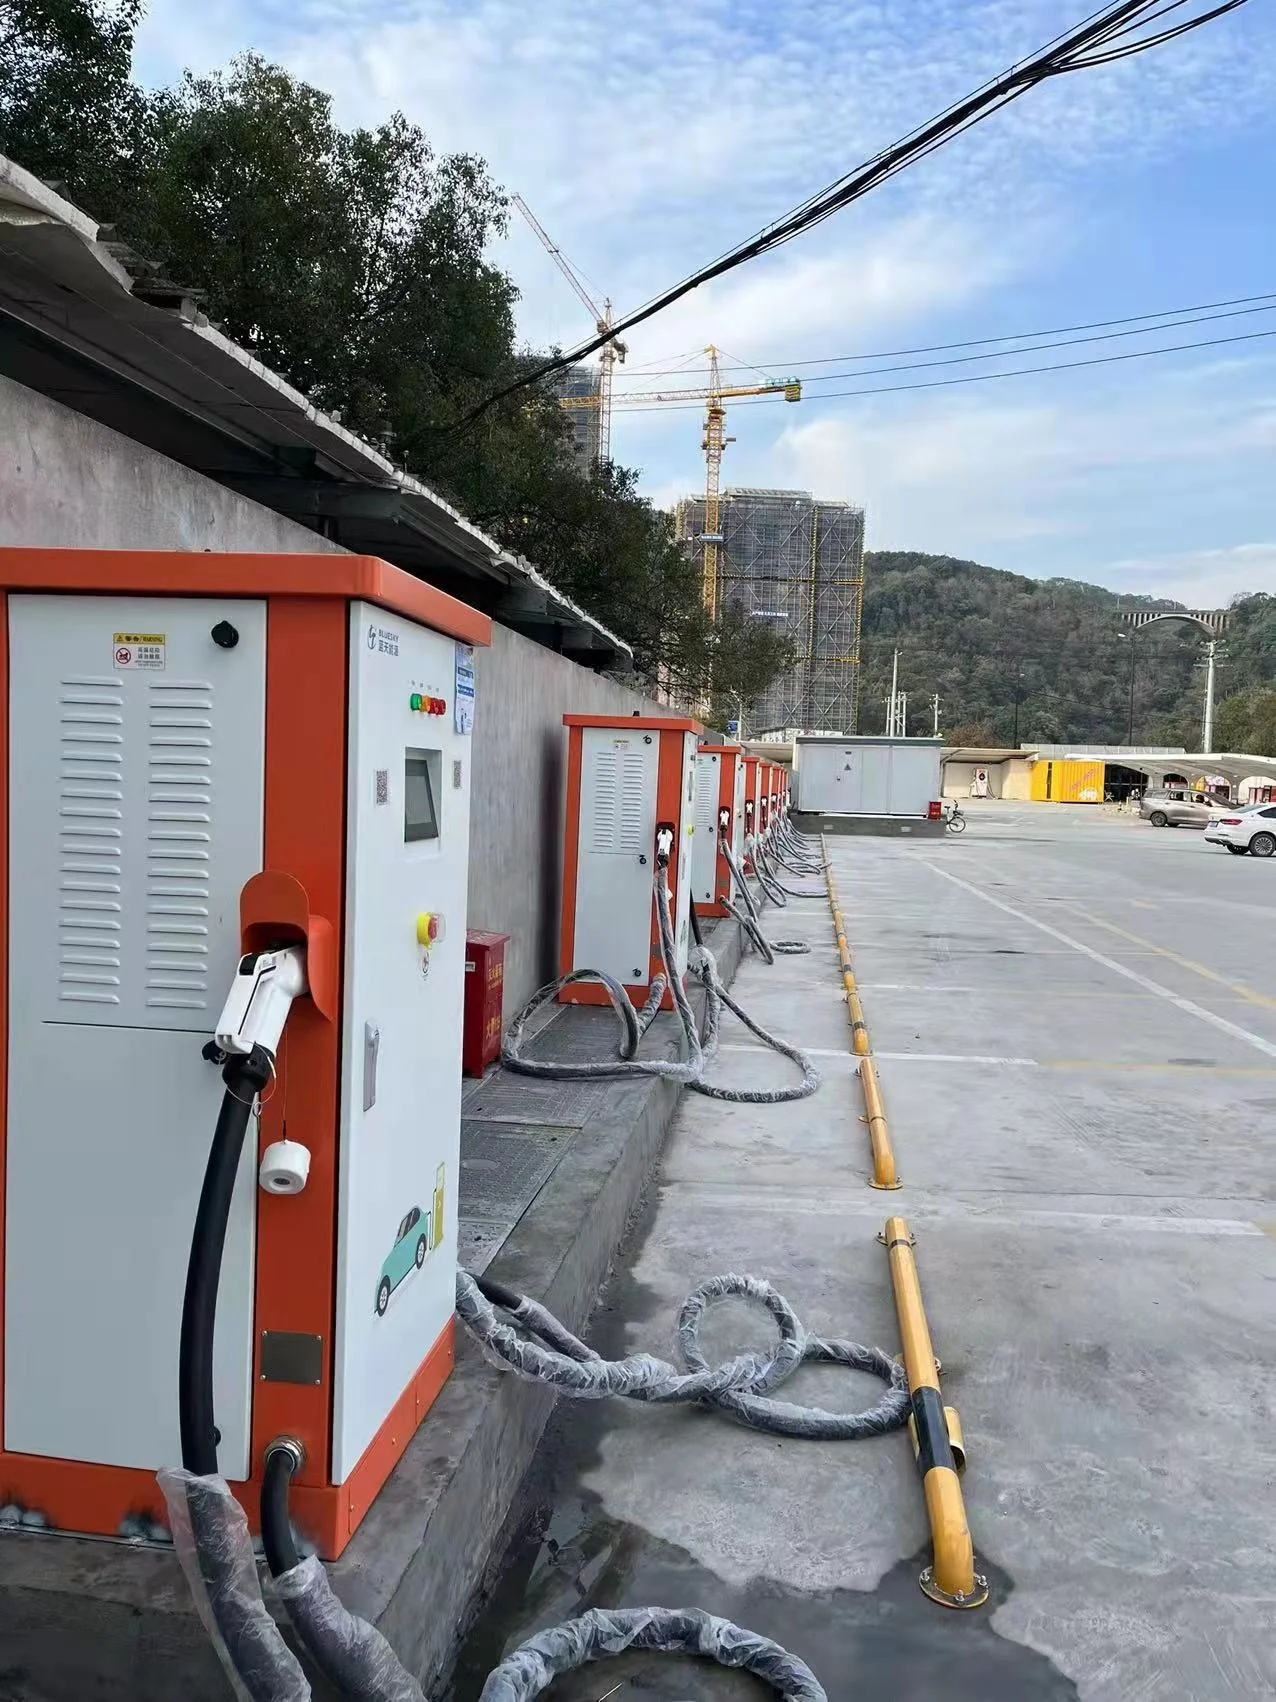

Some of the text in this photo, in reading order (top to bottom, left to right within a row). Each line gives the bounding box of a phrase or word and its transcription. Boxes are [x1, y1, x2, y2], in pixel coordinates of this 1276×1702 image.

[378, 629, 399, 643] BLUESKY
[378, 640, 399, 656] 蓝天能源
